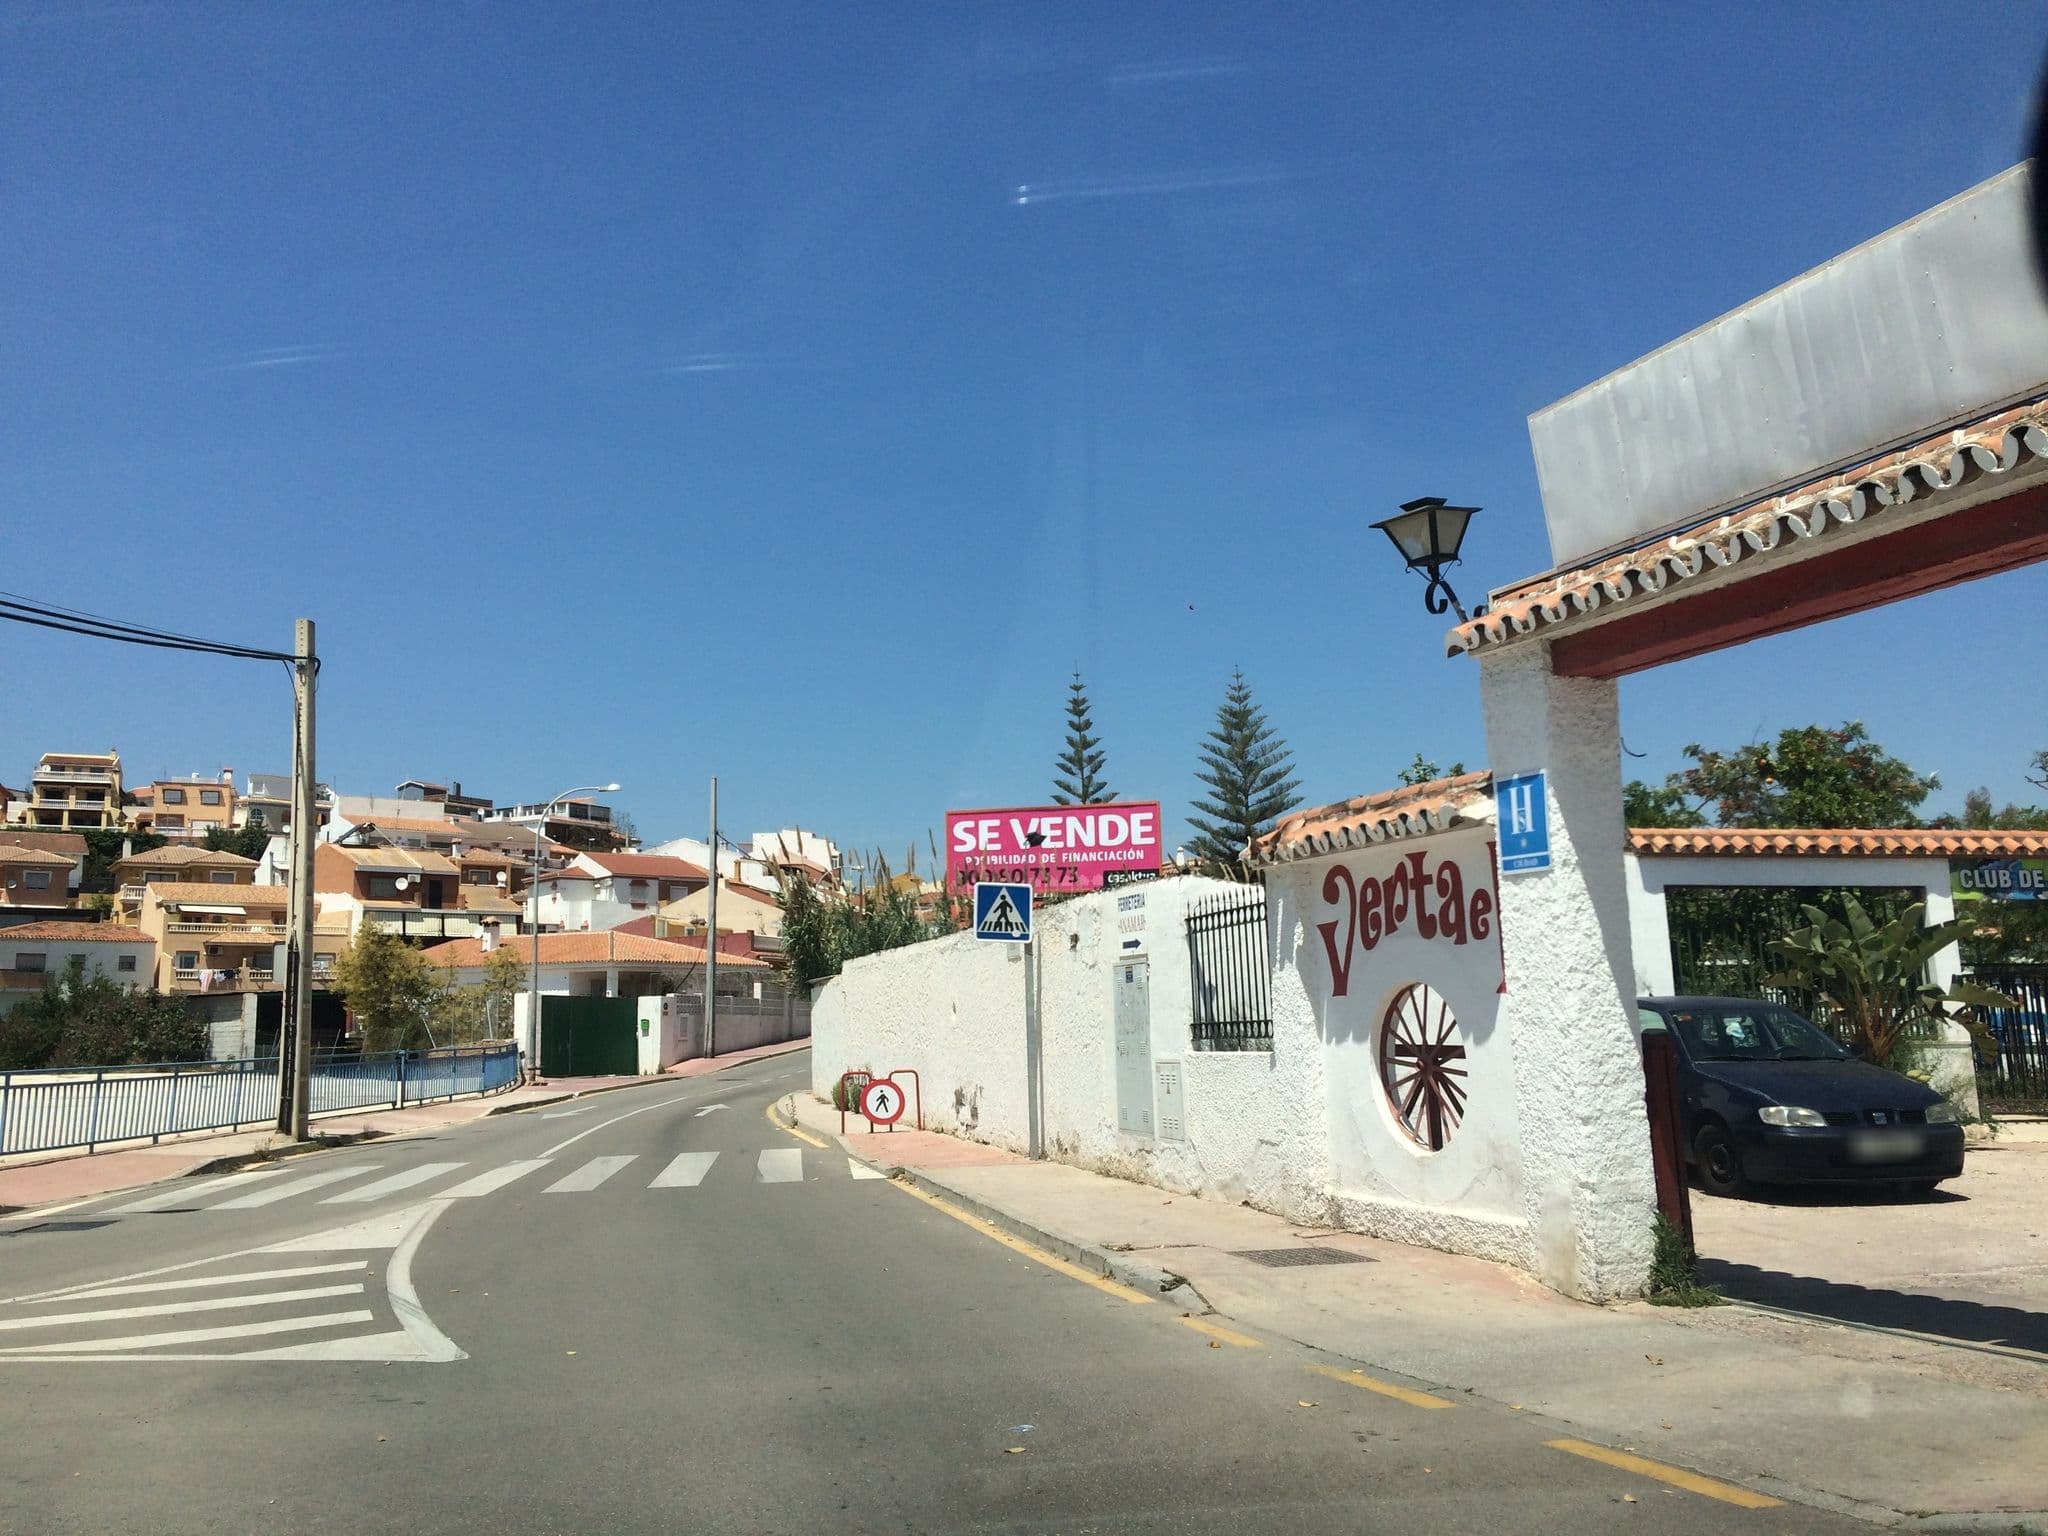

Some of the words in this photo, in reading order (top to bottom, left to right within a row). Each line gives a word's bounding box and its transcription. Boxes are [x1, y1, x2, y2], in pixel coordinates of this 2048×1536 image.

[953, 819, 1001, 853] SE
[1009, 812, 1156, 850] VENDE
[1041, 852, 1056, 863] DE
[1062, 848, 1145, 863] FINANCIACIÓN
[1960, 869, 2012, 889] CLUB
[2018, 869, 2045, 888] DE
